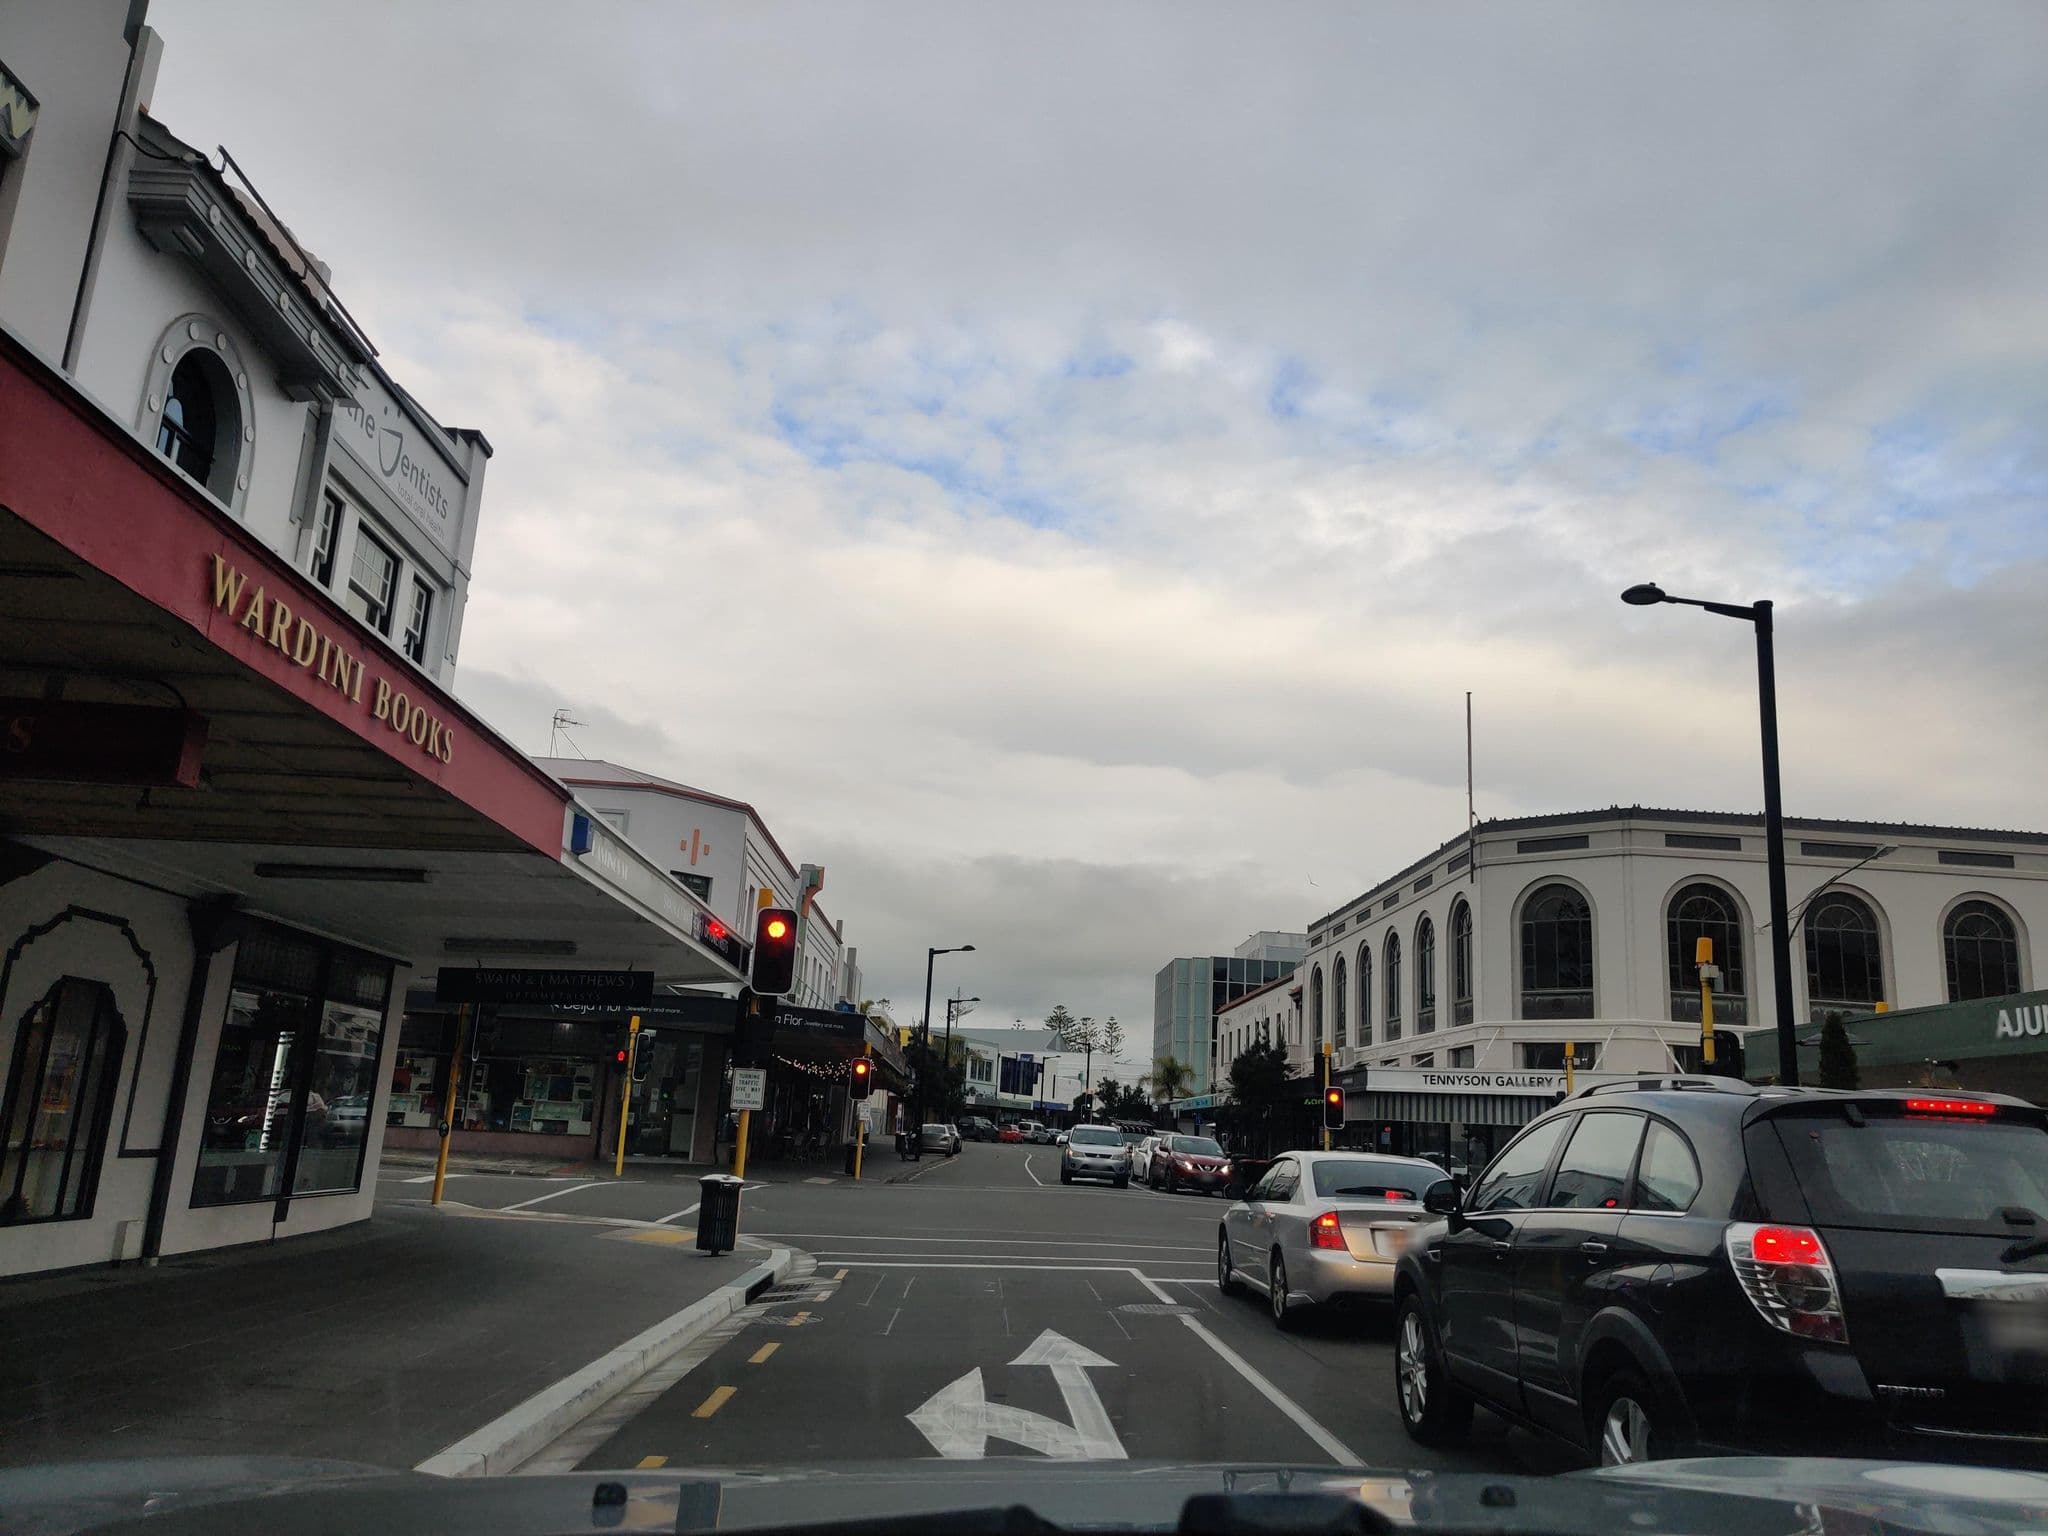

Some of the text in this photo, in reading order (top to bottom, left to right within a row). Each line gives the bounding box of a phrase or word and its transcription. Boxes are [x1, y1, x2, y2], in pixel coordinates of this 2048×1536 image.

[212, 552, 454, 765] WARDINI BOOKS
[1422, 1074, 1491, 1087] TENNYSON
[1495, 1075, 1553, 1088] GALLERY
